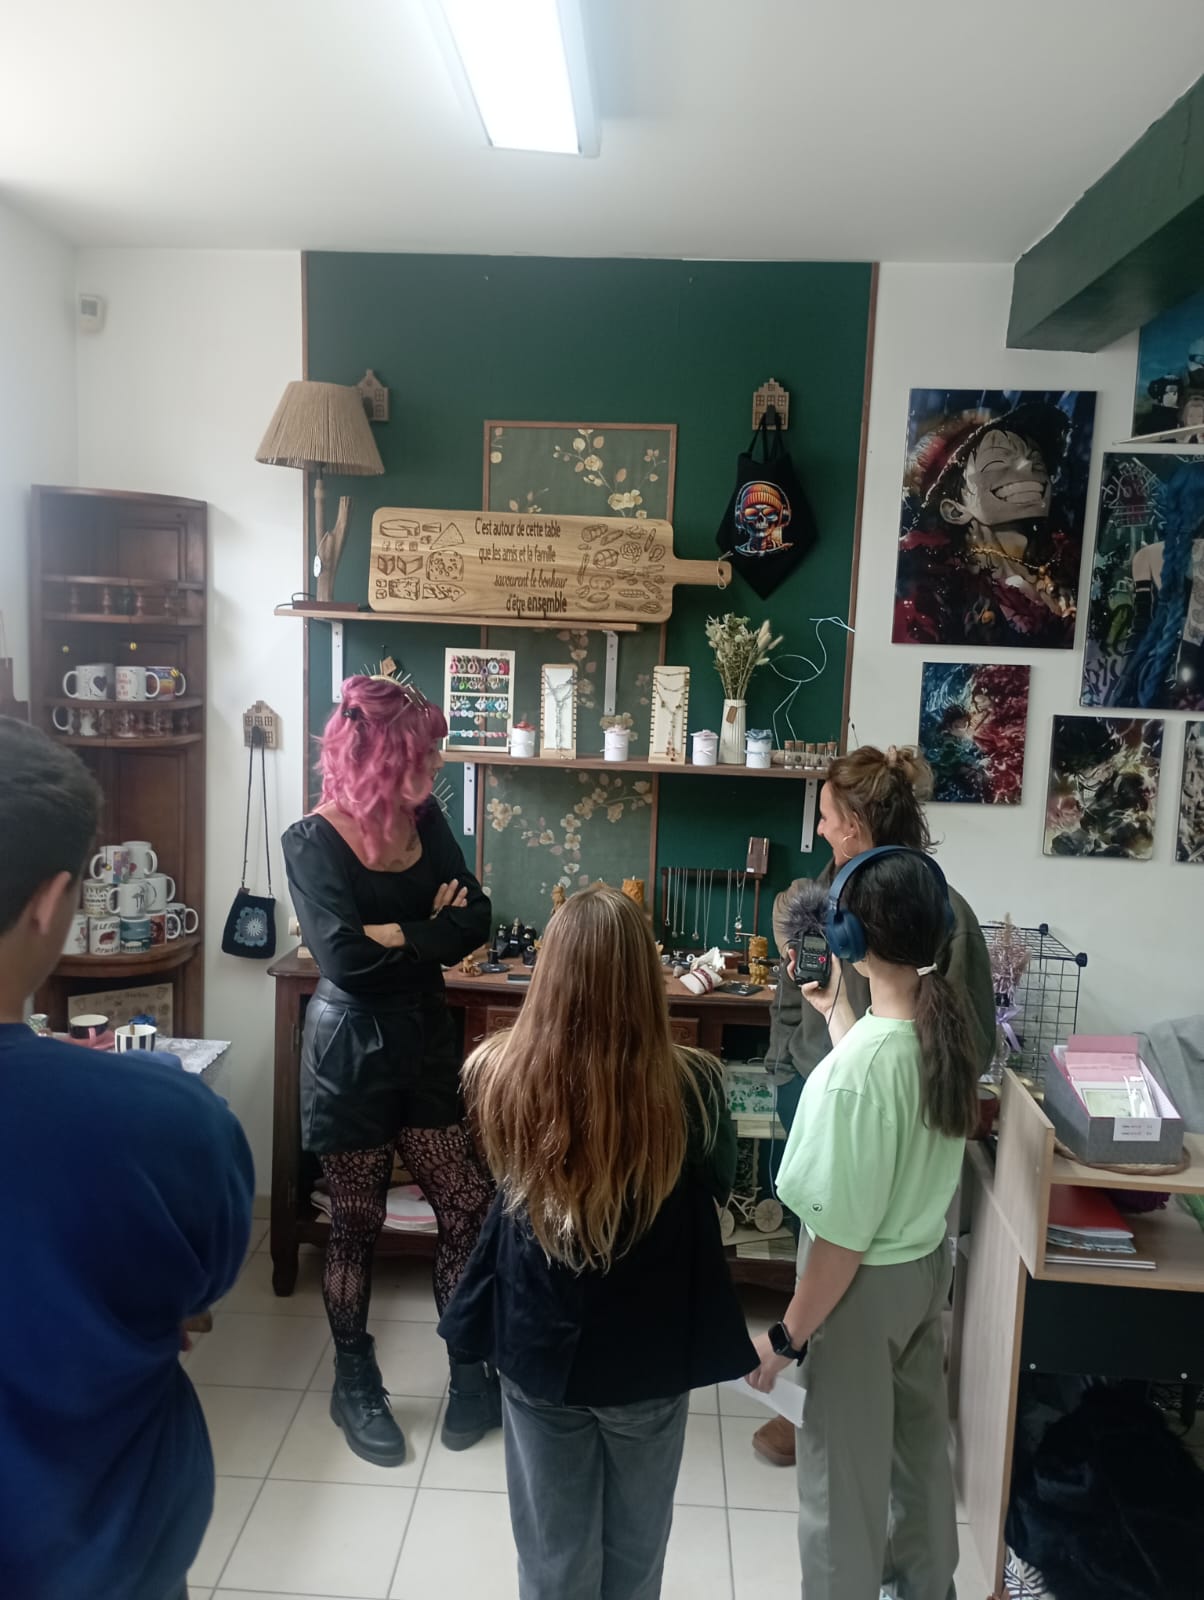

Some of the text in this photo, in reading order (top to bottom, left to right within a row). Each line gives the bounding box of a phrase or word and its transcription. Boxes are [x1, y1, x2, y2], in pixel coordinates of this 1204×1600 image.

[475, 517, 561, 538] C'est autour de cette table
[479, 548, 491, 565] que
[492, 543, 501, 561] les
[502, 544, 518, 561] amis
[519, 546, 526, 562] et
[534, 543, 556, 562] famille
[530, 567, 537, 588] le
[538, 567, 568, 588] bonheur
[527, 590, 567, 613] ensemble
